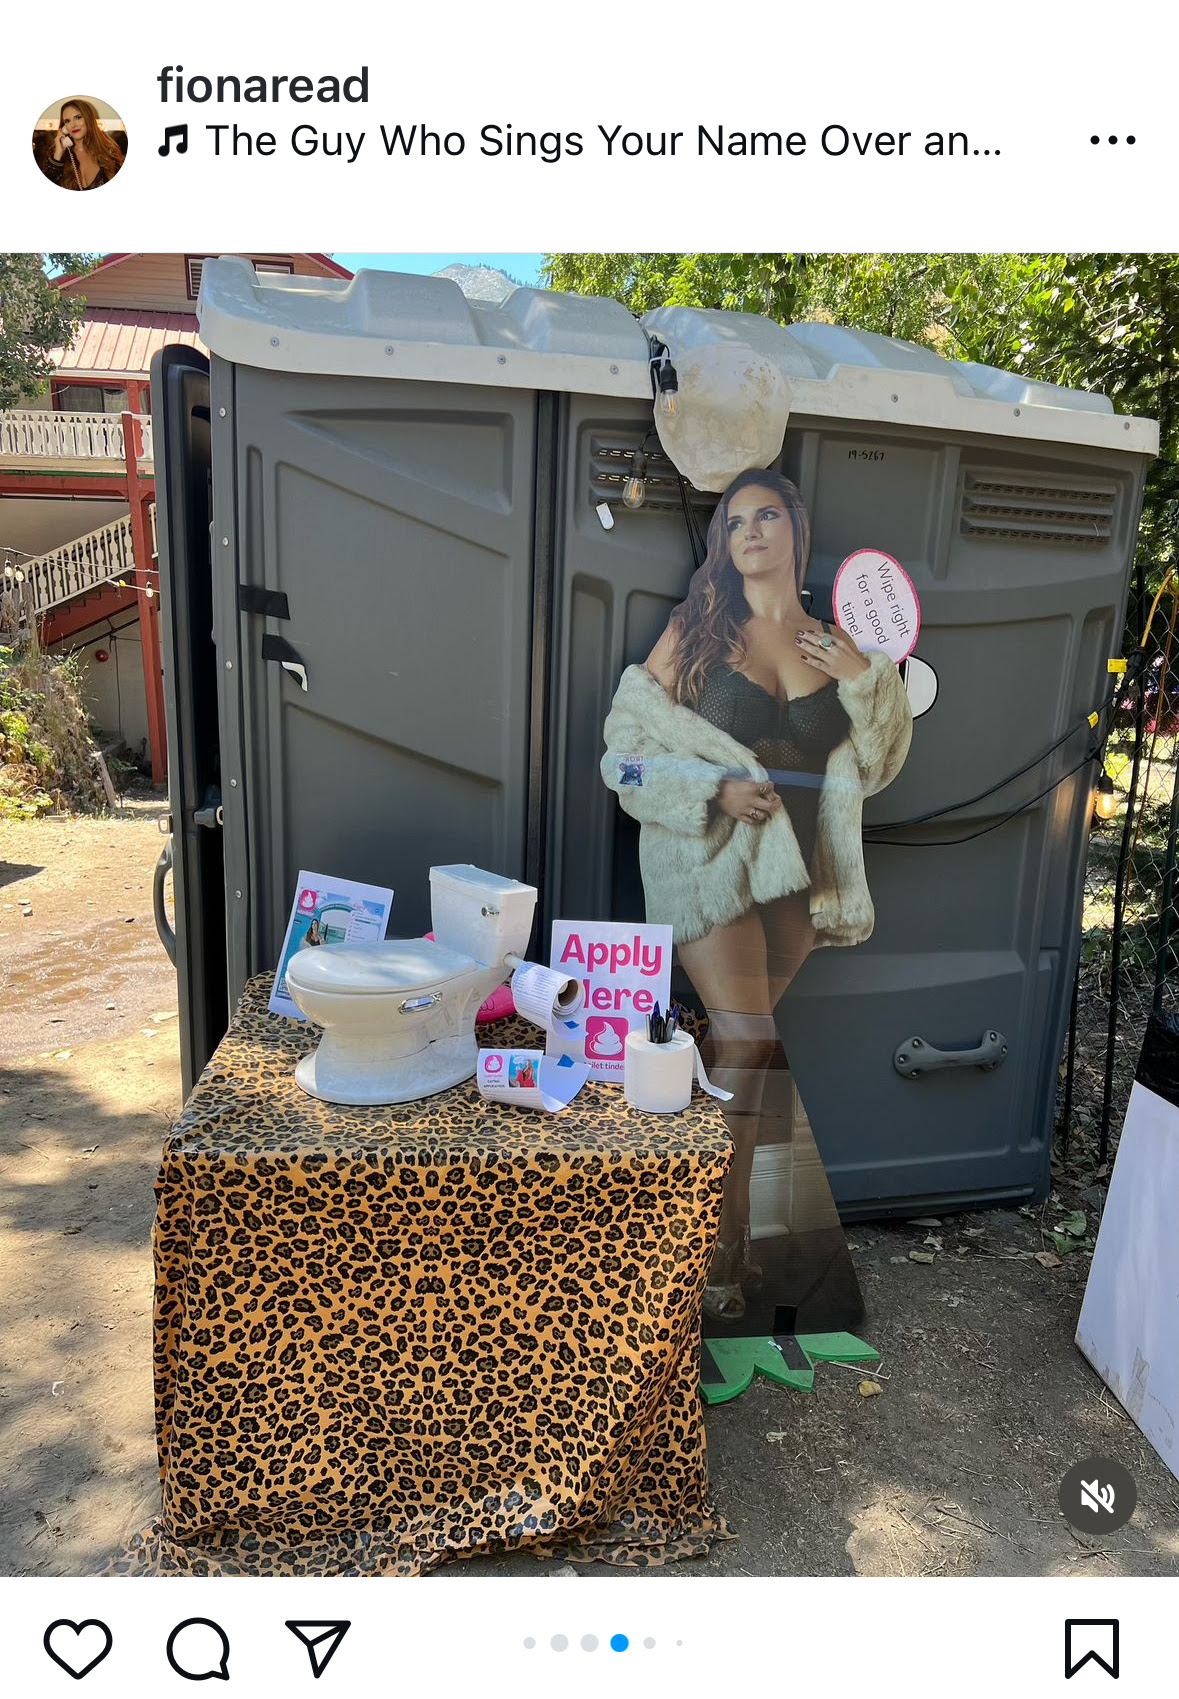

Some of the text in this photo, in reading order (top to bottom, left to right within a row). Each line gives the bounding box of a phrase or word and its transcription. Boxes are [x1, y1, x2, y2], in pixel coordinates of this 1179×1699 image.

[841, 601, 863, 637] time!
[856, 573, 890, 645] for a good
[877, 561, 911, 638] Wipe right
[559, 933, 663, 977] Apply
[604, 1062, 625, 1071] tinde
